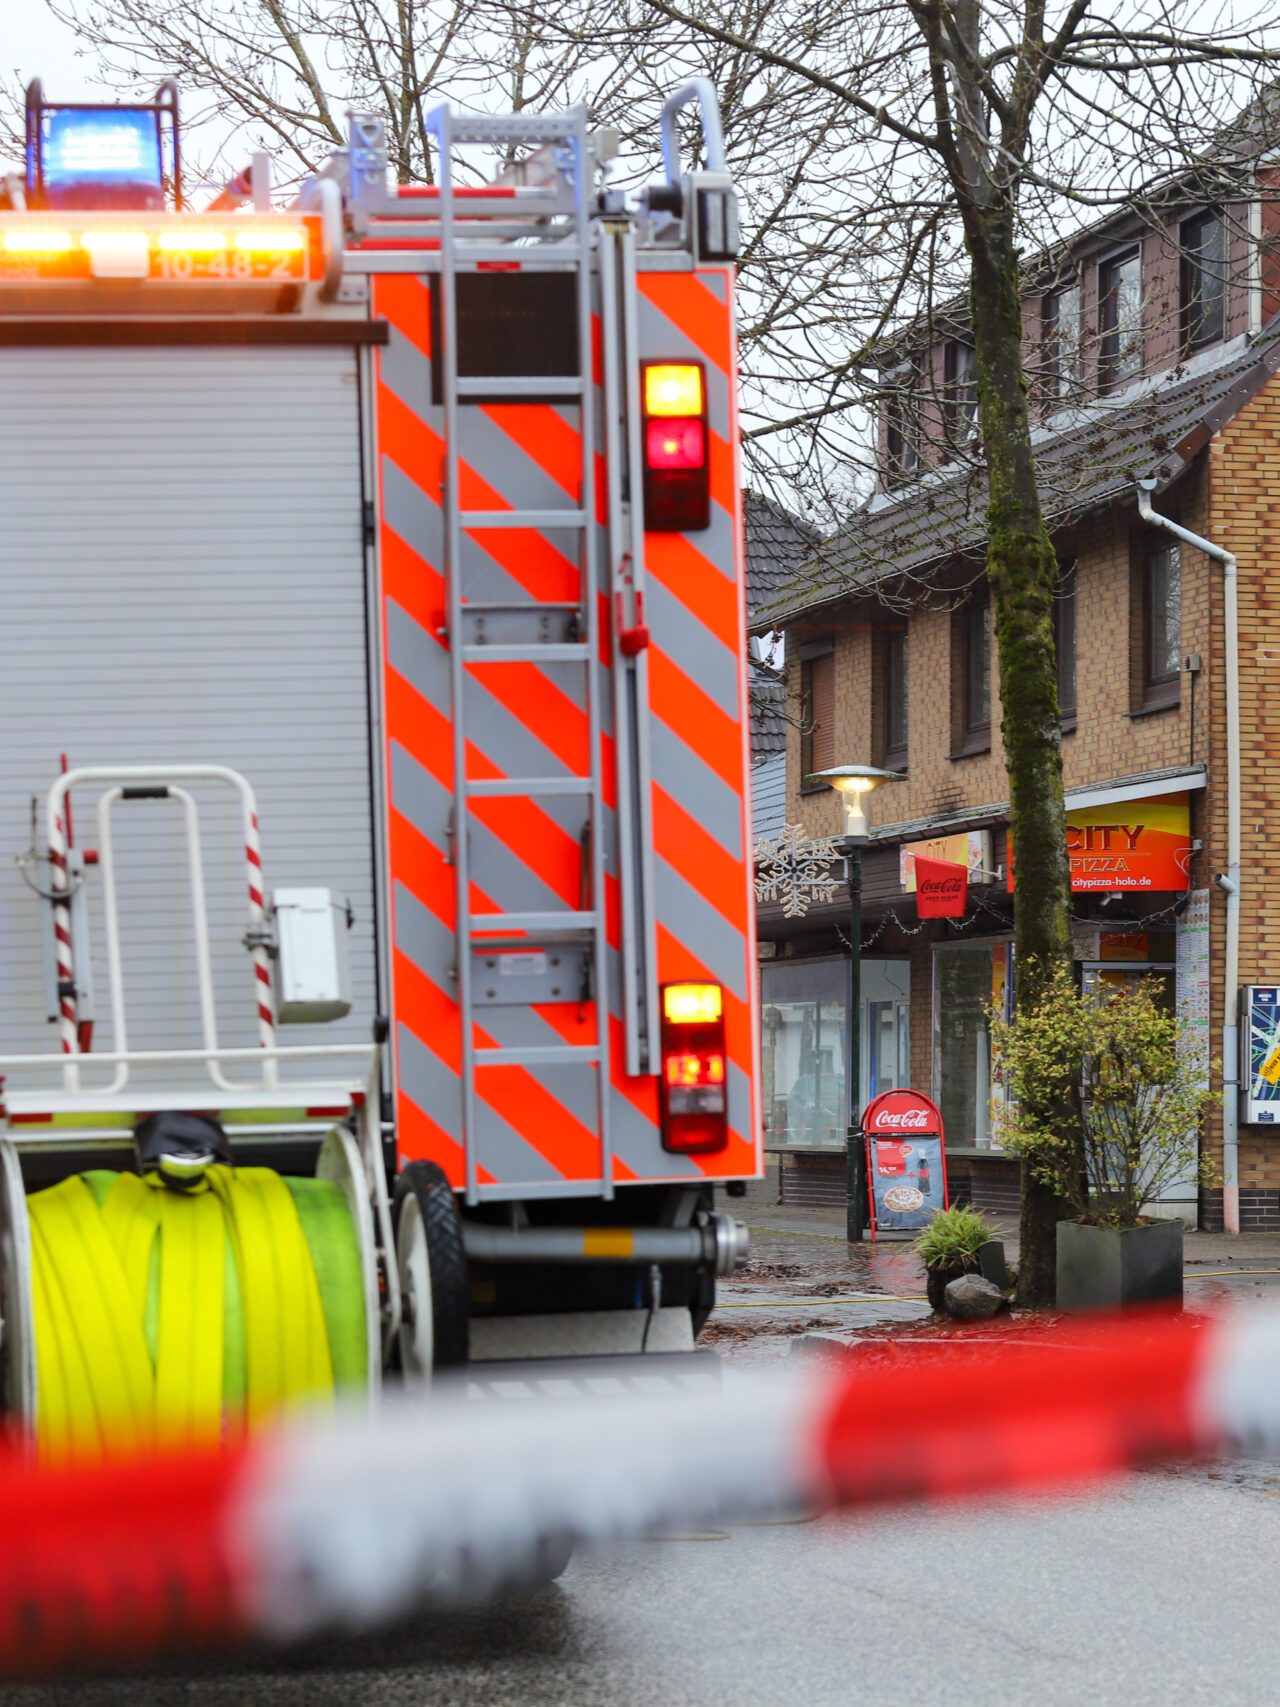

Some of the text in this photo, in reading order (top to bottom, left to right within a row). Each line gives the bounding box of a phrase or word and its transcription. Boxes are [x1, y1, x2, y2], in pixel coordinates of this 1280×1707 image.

[155, 251, 292, 277] 10-48-2
[1064, 824, 1145, 850] CITY
[1069, 857, 1131, 873] PIZZA
[1071, 876, 1152, 889] citypizza-holo.de
[875, 1109, 930, 1128] Coca-Cola
